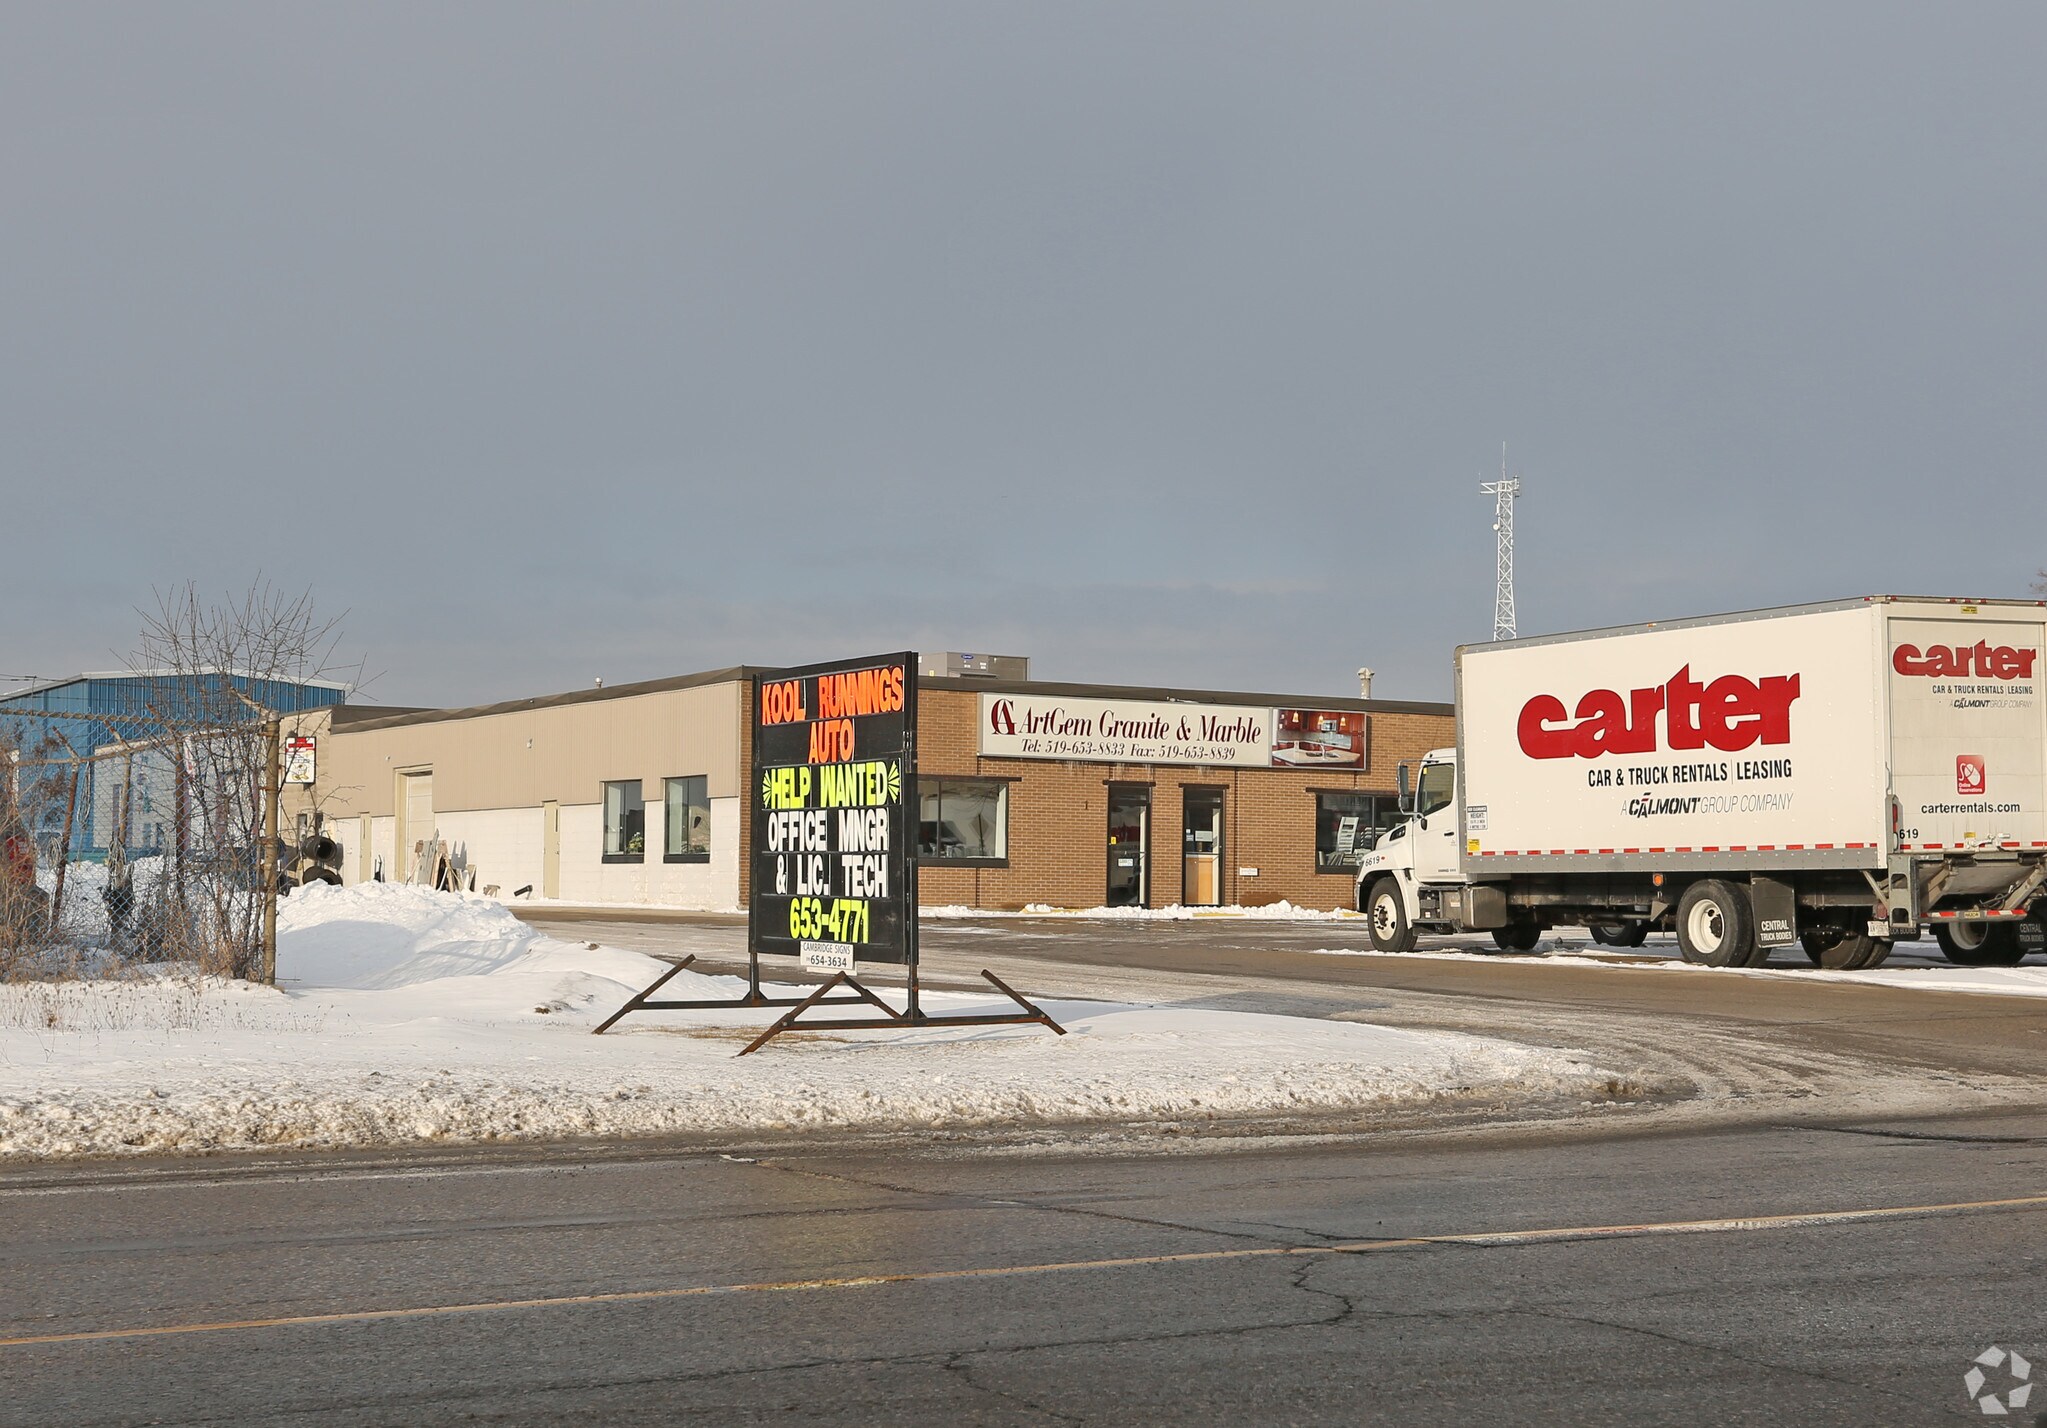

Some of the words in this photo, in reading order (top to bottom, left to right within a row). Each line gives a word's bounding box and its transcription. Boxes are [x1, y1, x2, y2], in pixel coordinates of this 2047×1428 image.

[1893, 638, 2036, 681] carter
[762, 680, 806, 726] KOOL
[818, 667, 903, 719] RUNNINGS
[1932, 685, 1946, 694] CAR
[1947, 685, 1953, 694] &
[1954, 685, 1976, 694] TRUCK
[1977, 685, 2004, 694] RENTALS
[2007, 685, 2033, 695] LEASING
[1517, 663, 1800, 759] carter
[1990, 700, 2008, 708] GROUP
[2008, 700, 2033, 708] COMPANY
[1018, 706, 1093, 737] ArtGem
[1099, 709, 1170, 740] Granite
[1176, 715, 1191, 741] &
[1196, 715, 1261, 744] Marble
[808, 718, 854, 764] AUTO
[1021, 738, 1042, 753] Tel:
[1045, 740, 1125, 756] 519-653-8833
[1130, 743, 1156, 757] Fax:
[1158, 745, 1236, 760] 519-653-8839
[1588, 769, 1612, 787] CAR
[1616, 768, 1625, 786] &
[1628, 766, 1669, 785] TRUCK
[1672, 762, 1728, 783] RENTALS
[1736, 758, 1793, 780] LEASING
[771, 766, 811, 809] HELP
[820, 761, 888, 808] WANTED
[1620, 801, 1628, 815] A
[1700, 796, 1739, 813] GROUP
[1740, 793, 1794, 812] COMPANY
[1921, 802, 2021, 814] carterrentals.com
[768, 810, 828, 852] OFFICE
[838, 807, 889, 852] MNGR
[1365, 855, 1380, 867] 6619
[776, 854, 787, 895] &
[796, 854, 829, 896] LIC.
[841, 854, 888, 898] TECH
[789, 897, 869, 944] 653-4771
[1761, 919, 1789, 932] CENTRAL
[2020, 923, 2042, 933] CENTRAL
[1760, 932, 1776, 941] TRUCK
[1776, 931, 1793, 941] BODIES
[803, 942, 833, 953] CAMBRIDGE
[834, 944, 851, 955] SIGNS
[810, 955, 848, 967] 654-3634
